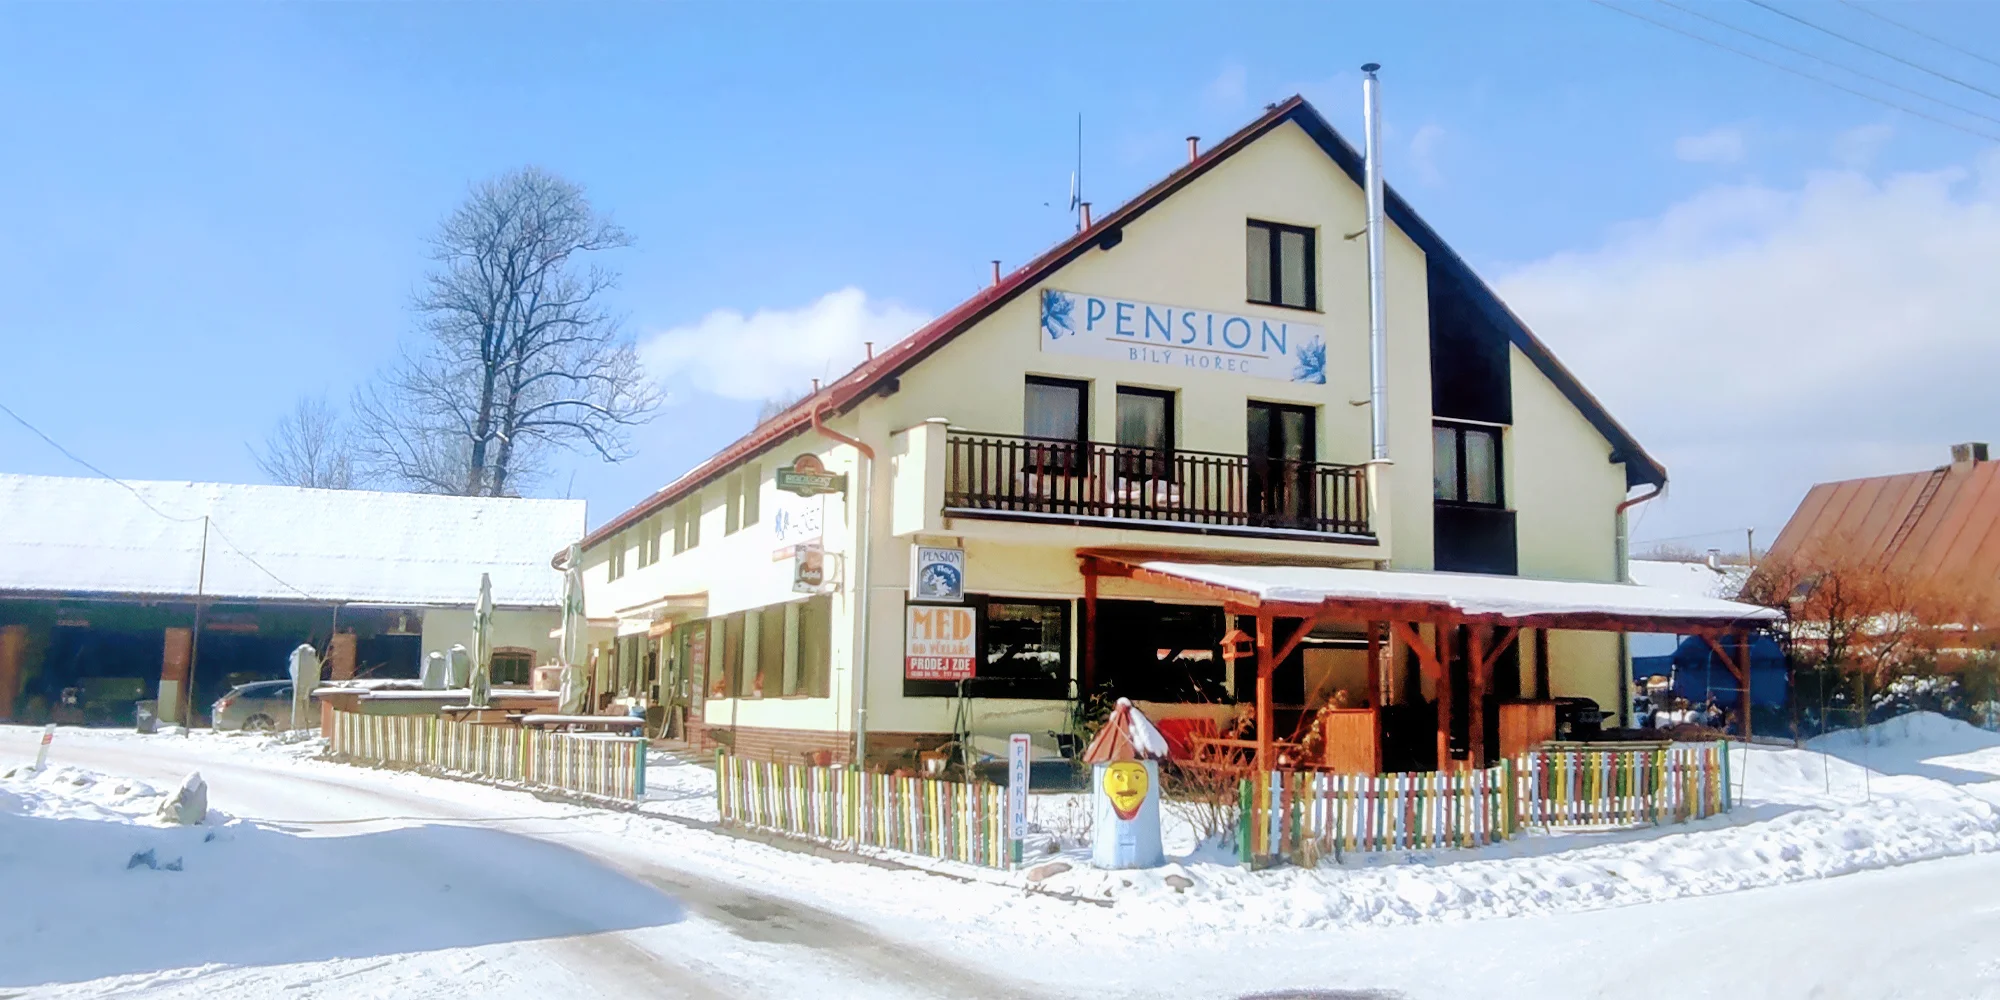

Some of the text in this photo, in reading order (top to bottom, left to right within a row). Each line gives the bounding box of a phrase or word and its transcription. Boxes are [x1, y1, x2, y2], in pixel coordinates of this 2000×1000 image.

[1086, 297, 1287, 355] PENSION
[1129, 347, 1250, 373] BÍLÝ HOŘEC
[922, 551, 961, 563] PENSION
[912, 608, 972, 640] MED
[911, 658, 971, 671] PRODEJ ZDE
[1015, 746, 1024, 836] PARKING
